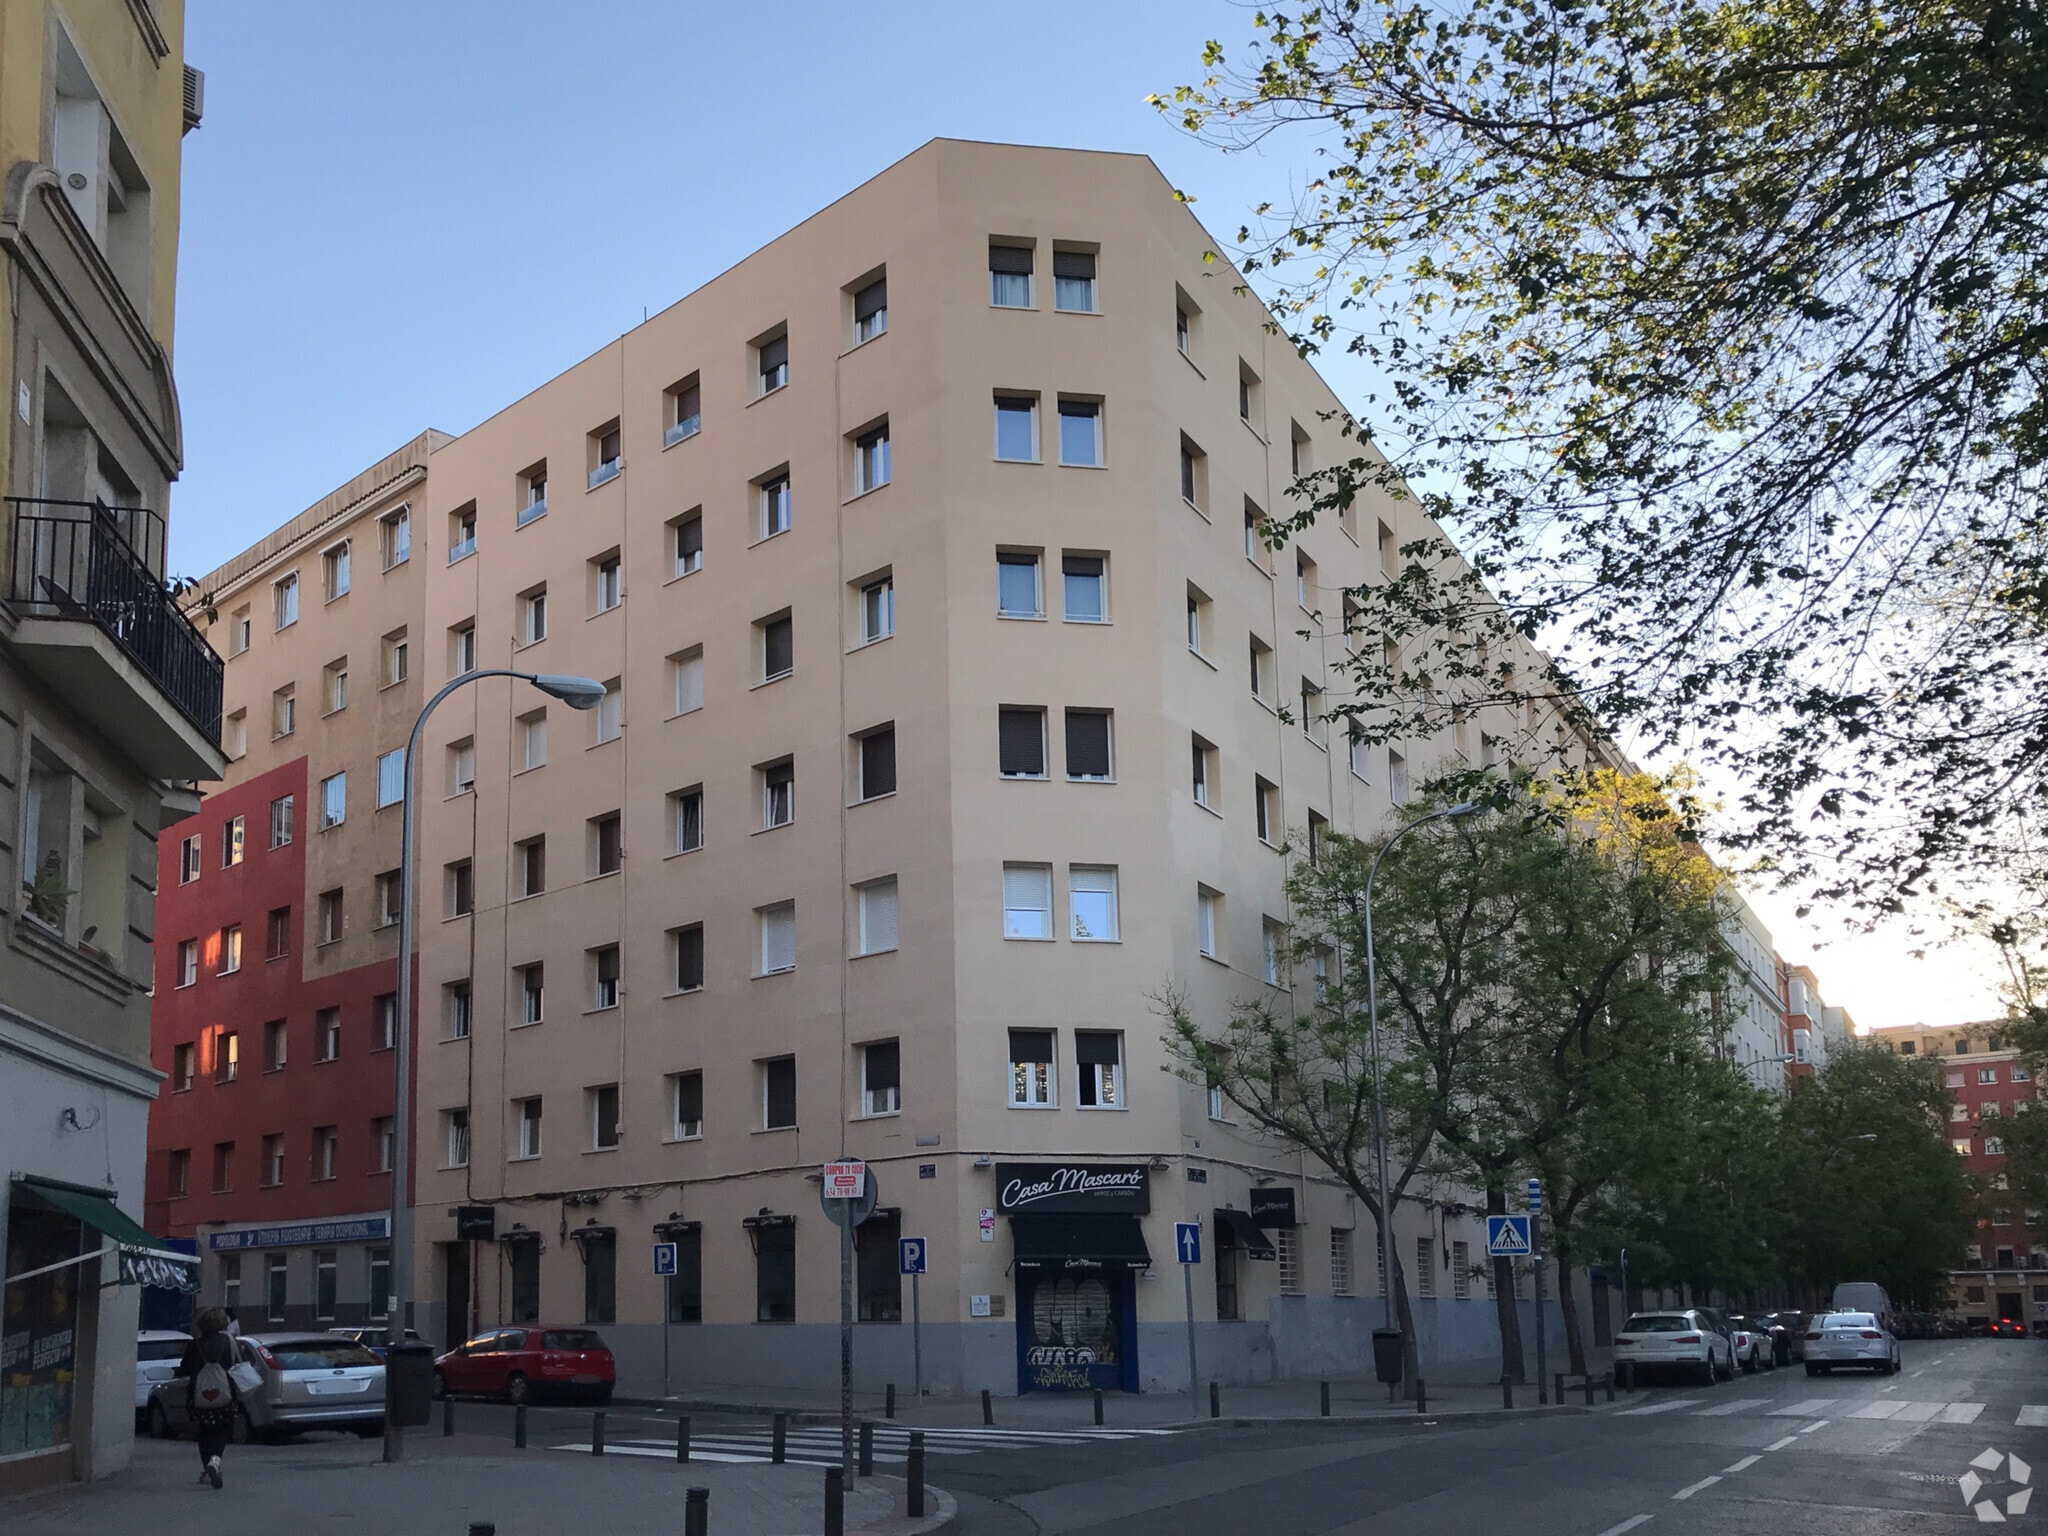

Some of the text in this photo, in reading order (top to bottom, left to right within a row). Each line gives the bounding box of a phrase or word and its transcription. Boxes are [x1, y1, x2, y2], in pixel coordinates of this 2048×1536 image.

[1002, 1168, 1143, 1207] Casa Mascaró
[657, 1248, 671, 1272] P
[904, 1242, 920, 1270] P
